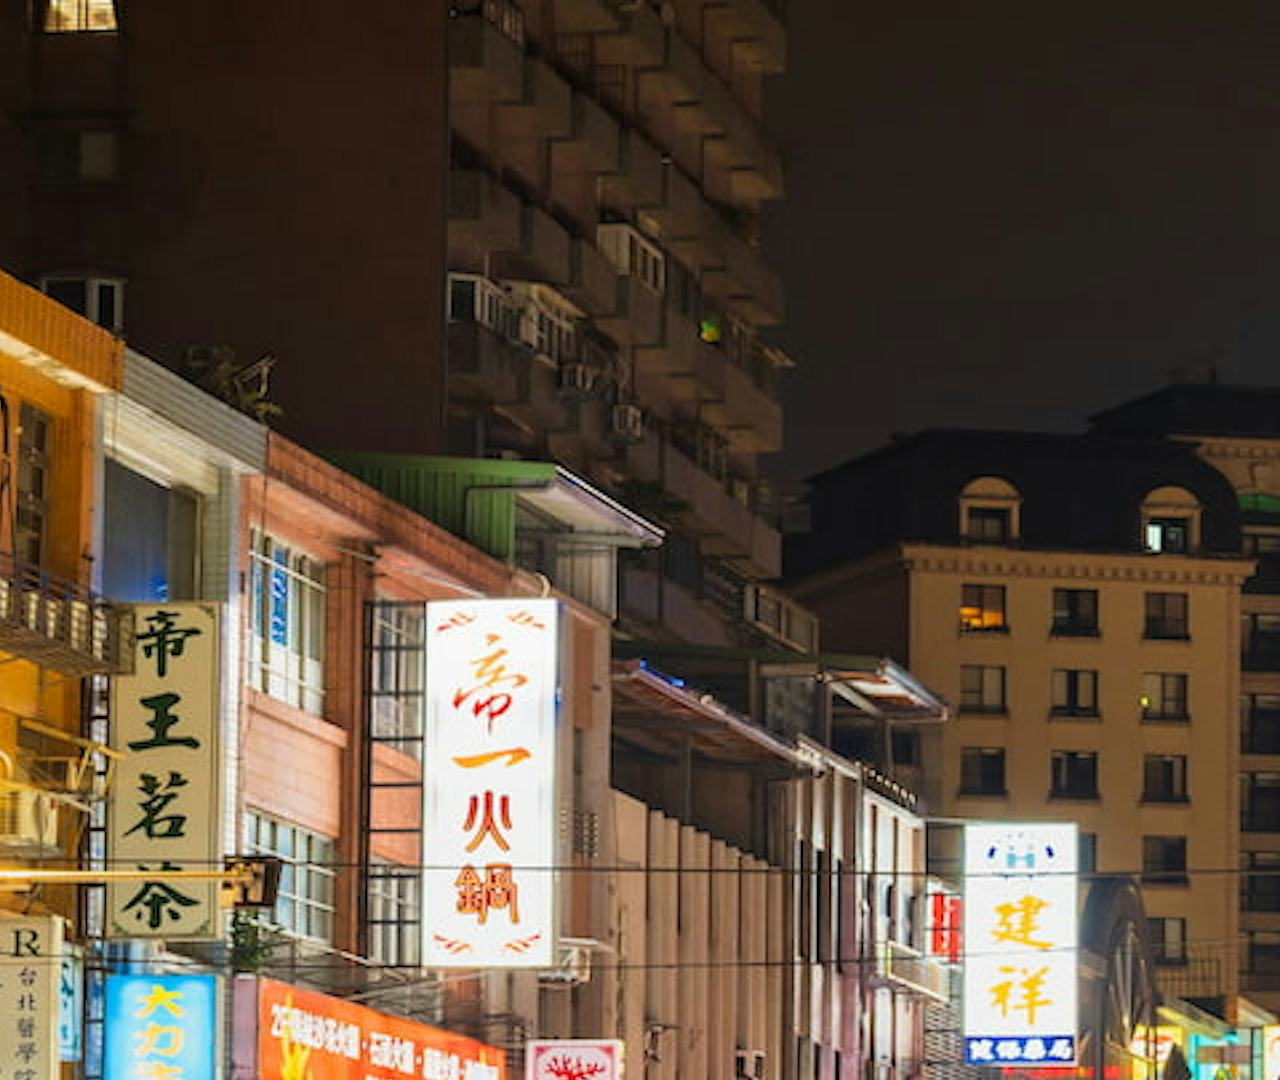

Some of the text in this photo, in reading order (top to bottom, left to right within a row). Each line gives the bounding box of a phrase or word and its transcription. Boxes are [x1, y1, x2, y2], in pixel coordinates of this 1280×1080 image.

[122, 610, 202, 929] 帝王茗茶
[451, 633, 532, 925] 帝一火鍋
[988, 895, 1056, 1026] 建祥
